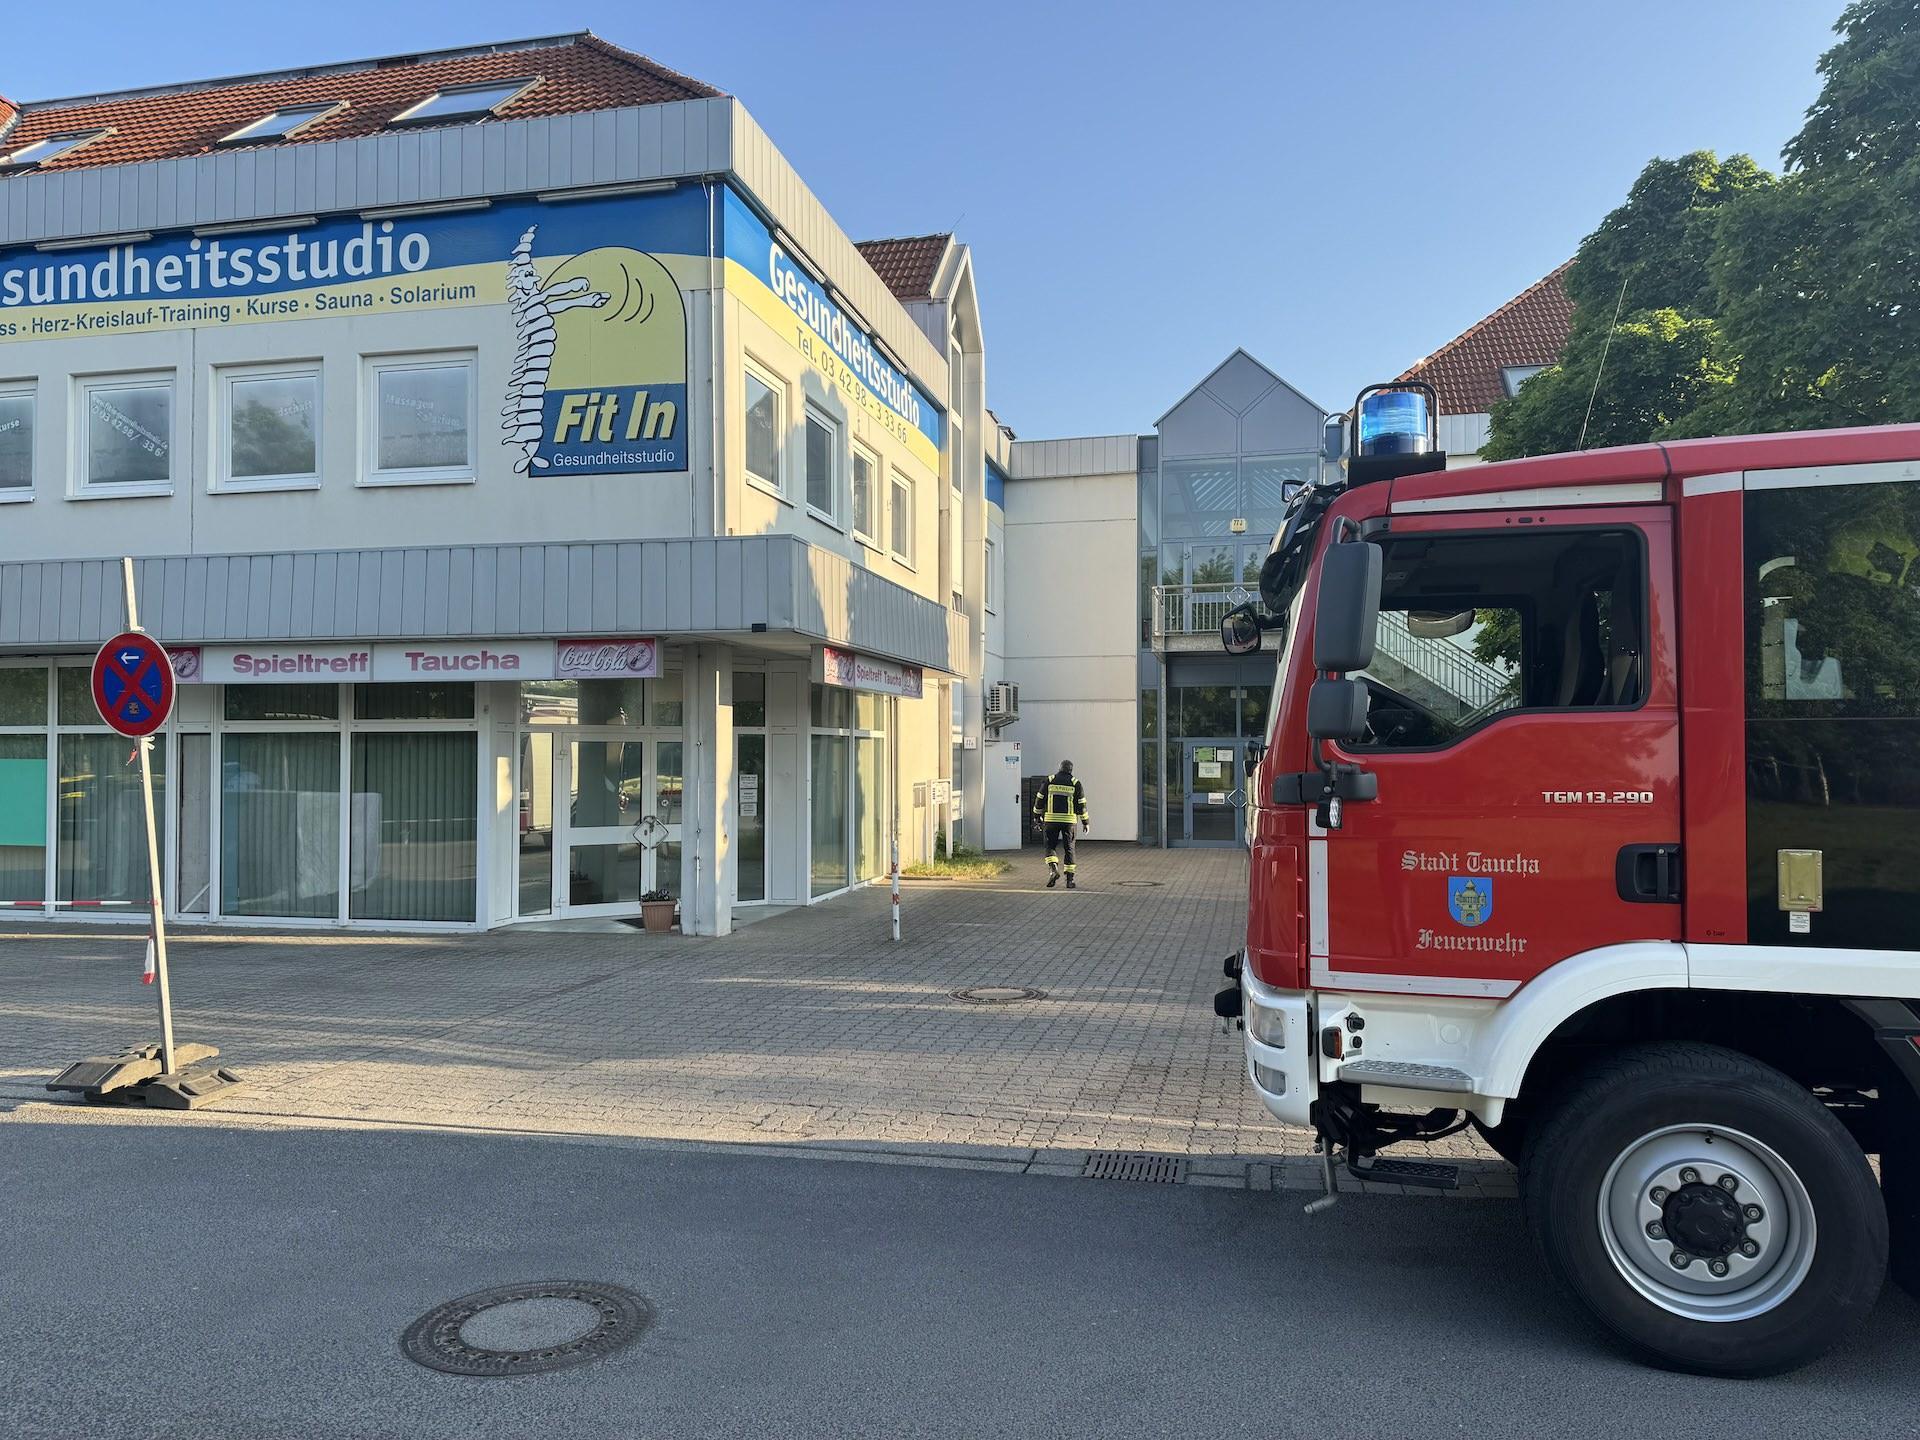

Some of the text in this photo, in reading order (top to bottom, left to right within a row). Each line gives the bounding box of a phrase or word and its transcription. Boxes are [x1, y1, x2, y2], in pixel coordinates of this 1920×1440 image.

[3, 220, 430, 306] sundheitsstudio
[32, 303, 231, 333] Herz-Kreislauf-Training
[247, 299, 299, 316] Kurse
[315, 293, 373, 311] Sauna
[391, 283, 476, 304] Solarium
[769, 242, 920, 428] Gesundheitsstudio
[796, 326, 818, 363] Tel.
[821, 351, 835, 378] 03
[839, 367, 852, 393] 42
[855, 382, 867, 407] 98
[884, 413, 895, 432] 33
[897, 423, 907, 444] 66
[553, 391, 677, 443] Fit In
[553, 449, 675, 467] Gesundheitsstudio
[233, 650, 520, 676] Spieltreff Taucha
[1542, 791, 1654, 804] TGM 13.290
[1401, 850, 1540, 878] Stadt Taucha
[1415, 929, 1528, 957] Feuerwehr
